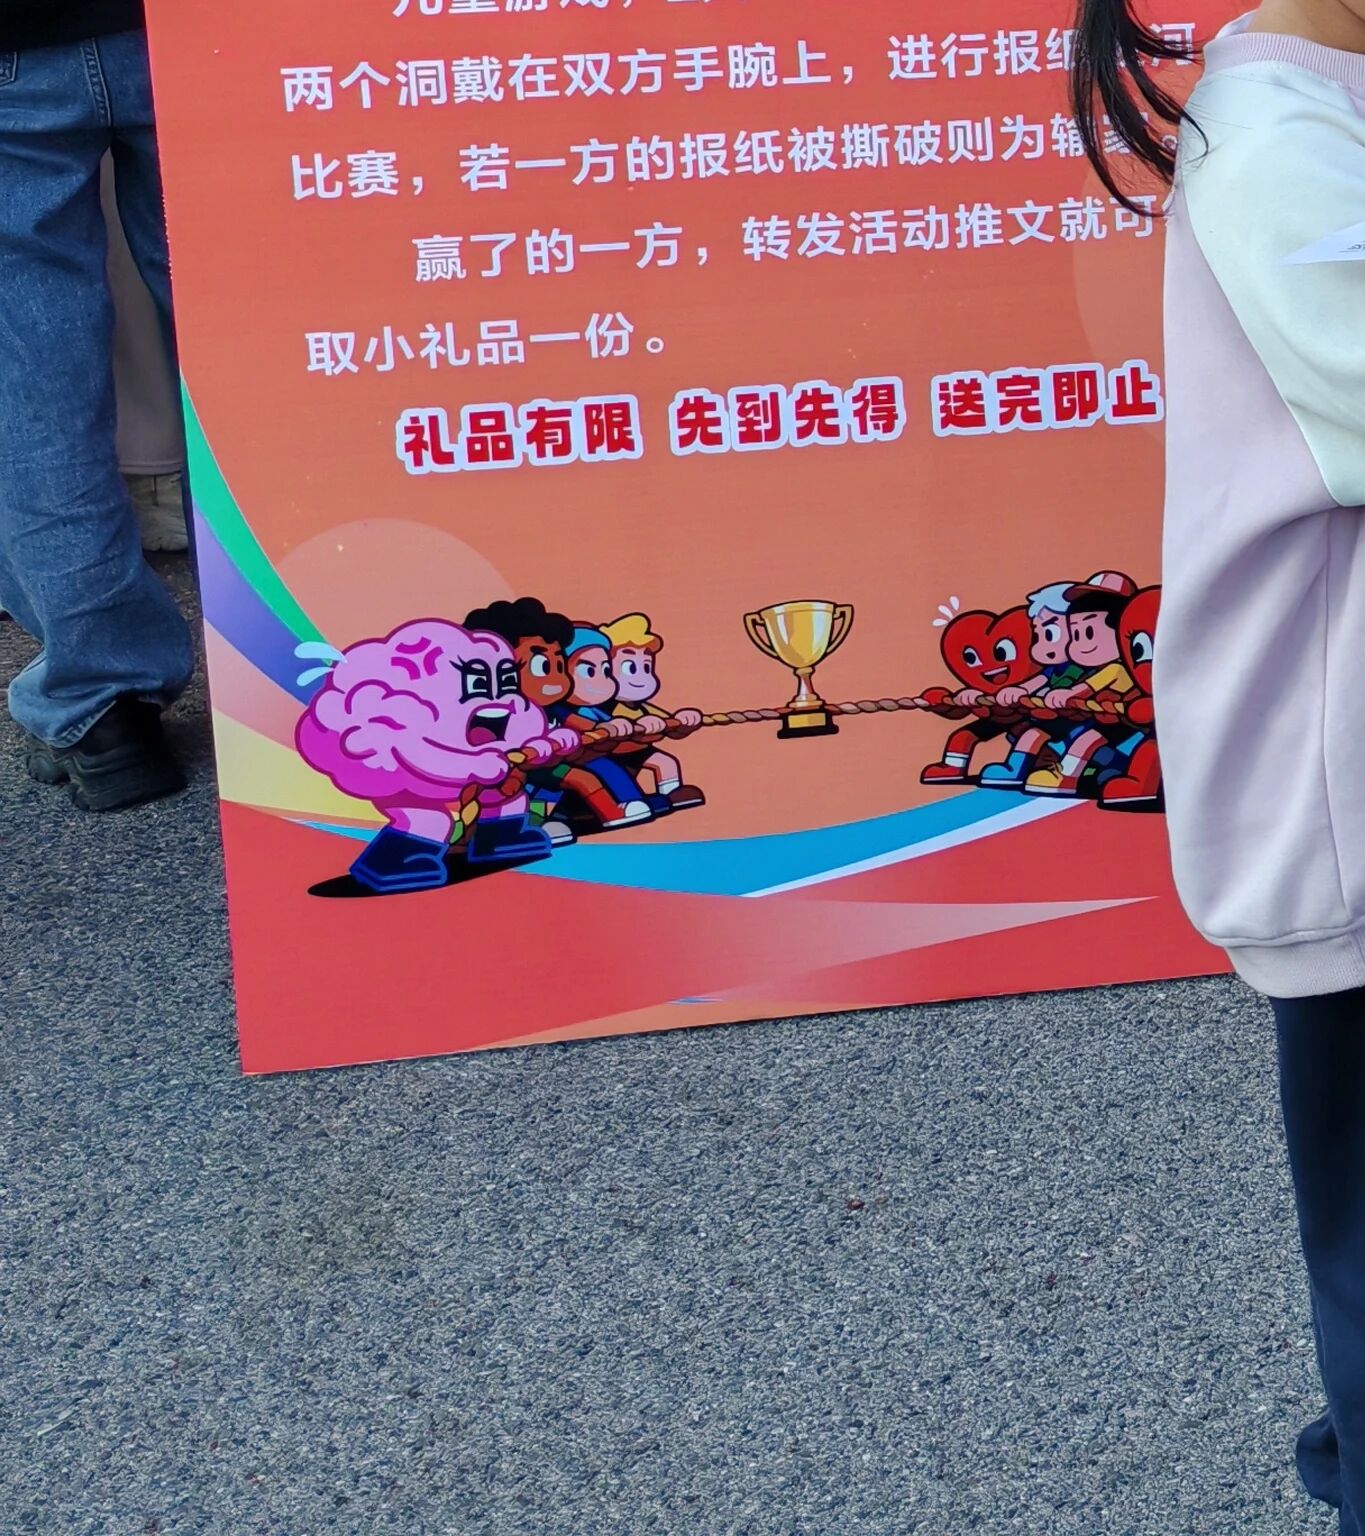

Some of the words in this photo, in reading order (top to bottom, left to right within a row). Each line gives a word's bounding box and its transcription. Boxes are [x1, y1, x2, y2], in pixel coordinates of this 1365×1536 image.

[280, 22, 1196, 112] 两个洞戴在双方手腕上，进行报纸河
[411, 187, 1175, 283] 赢了的一方，转发活动推文就可
[304, 310, 667, 376] 取小礼品一份。
[400, 397, 640, 470] 礼品有限
[672, 379, 902, 453] 先到先得
[934, 365, 1160, 431] 送完即止
